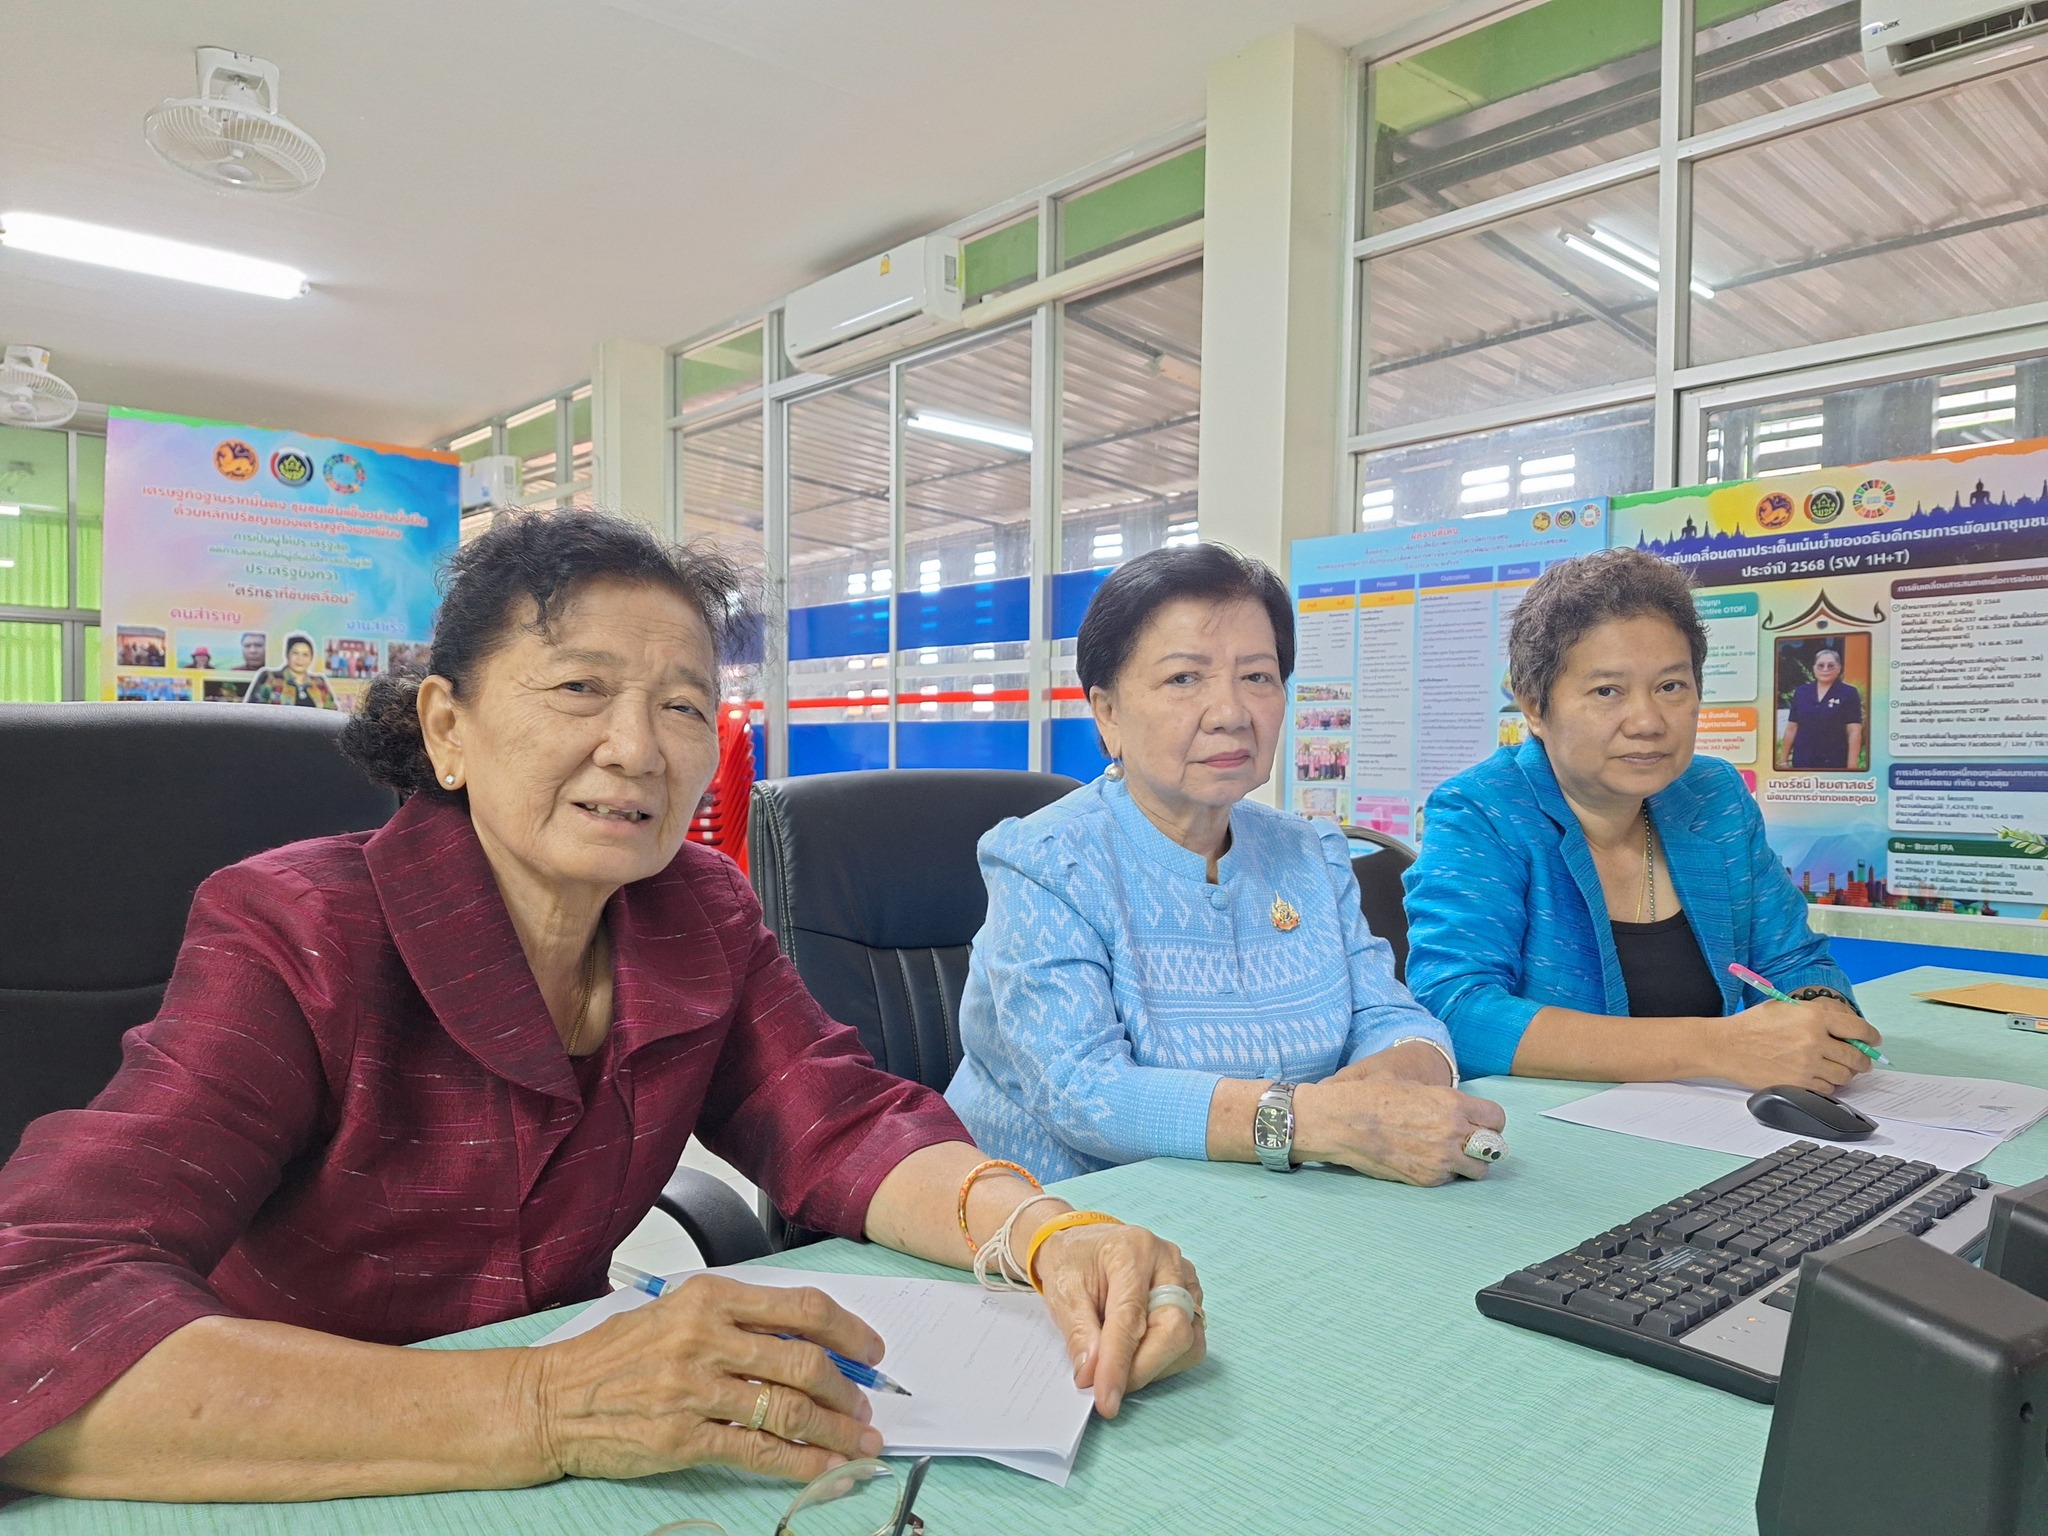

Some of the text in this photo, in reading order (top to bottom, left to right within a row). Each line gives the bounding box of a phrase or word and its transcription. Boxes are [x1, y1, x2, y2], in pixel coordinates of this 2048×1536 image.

[1741, 548, 1911, 578] ประจำปี 2568 (5W 1H+T)
[1723, 603, 1747, 614] OTOP)
[170, 607, 242, 625] คนสำราญ
[1894, 841, 1906, 850] Re
[1914, 842, 1939, 851] Brand
[1939, 843, 1954, 852] IPA
